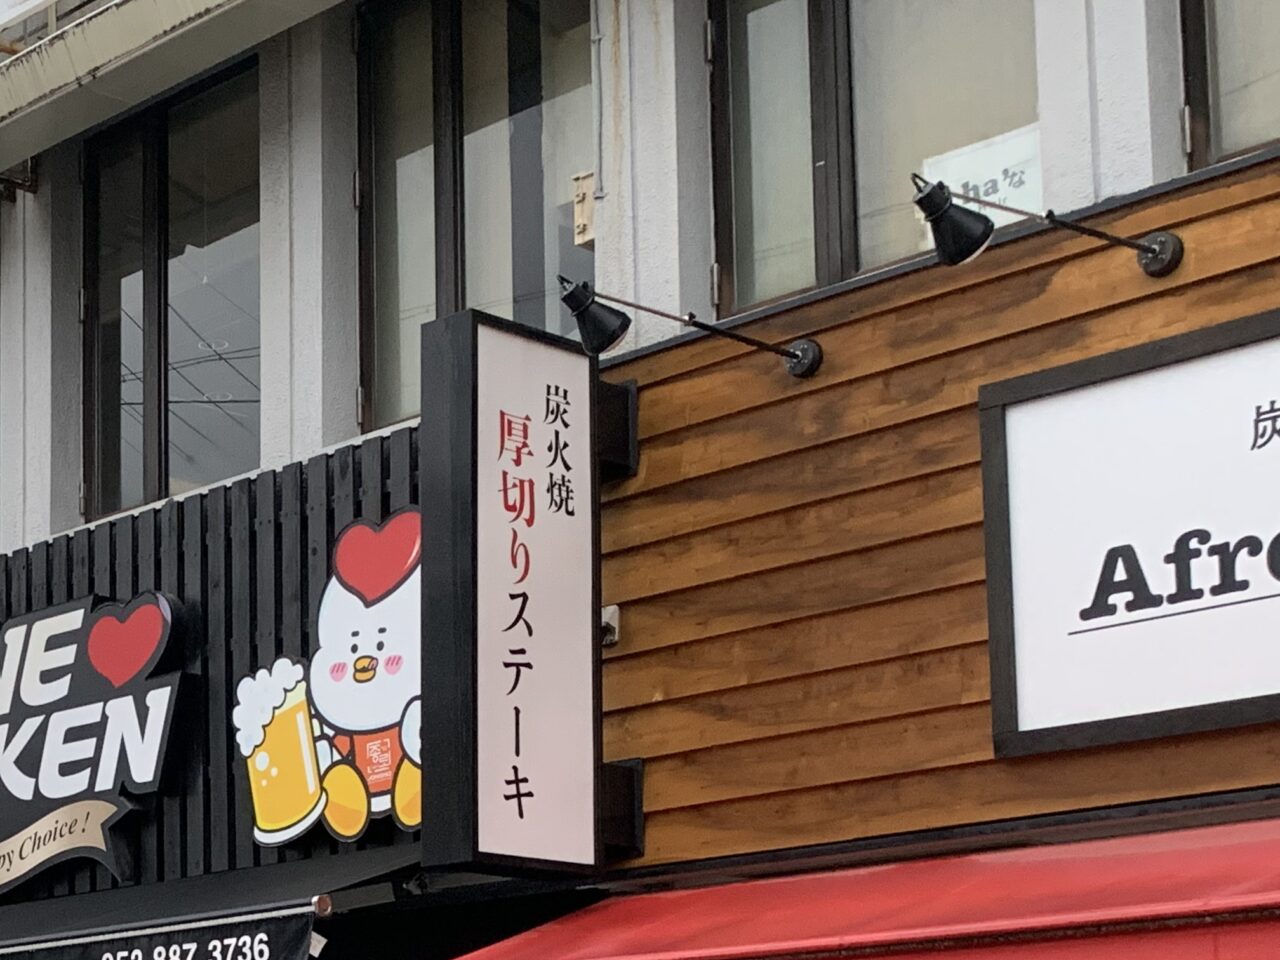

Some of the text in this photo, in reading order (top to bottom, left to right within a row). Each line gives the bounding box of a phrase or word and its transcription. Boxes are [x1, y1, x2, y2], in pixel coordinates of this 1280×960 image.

[544, 383, 575, 517] 炭火焼
[498, 409, 535, 820] 厚切りステーキ
[19, 818, 78, 861] Choice
